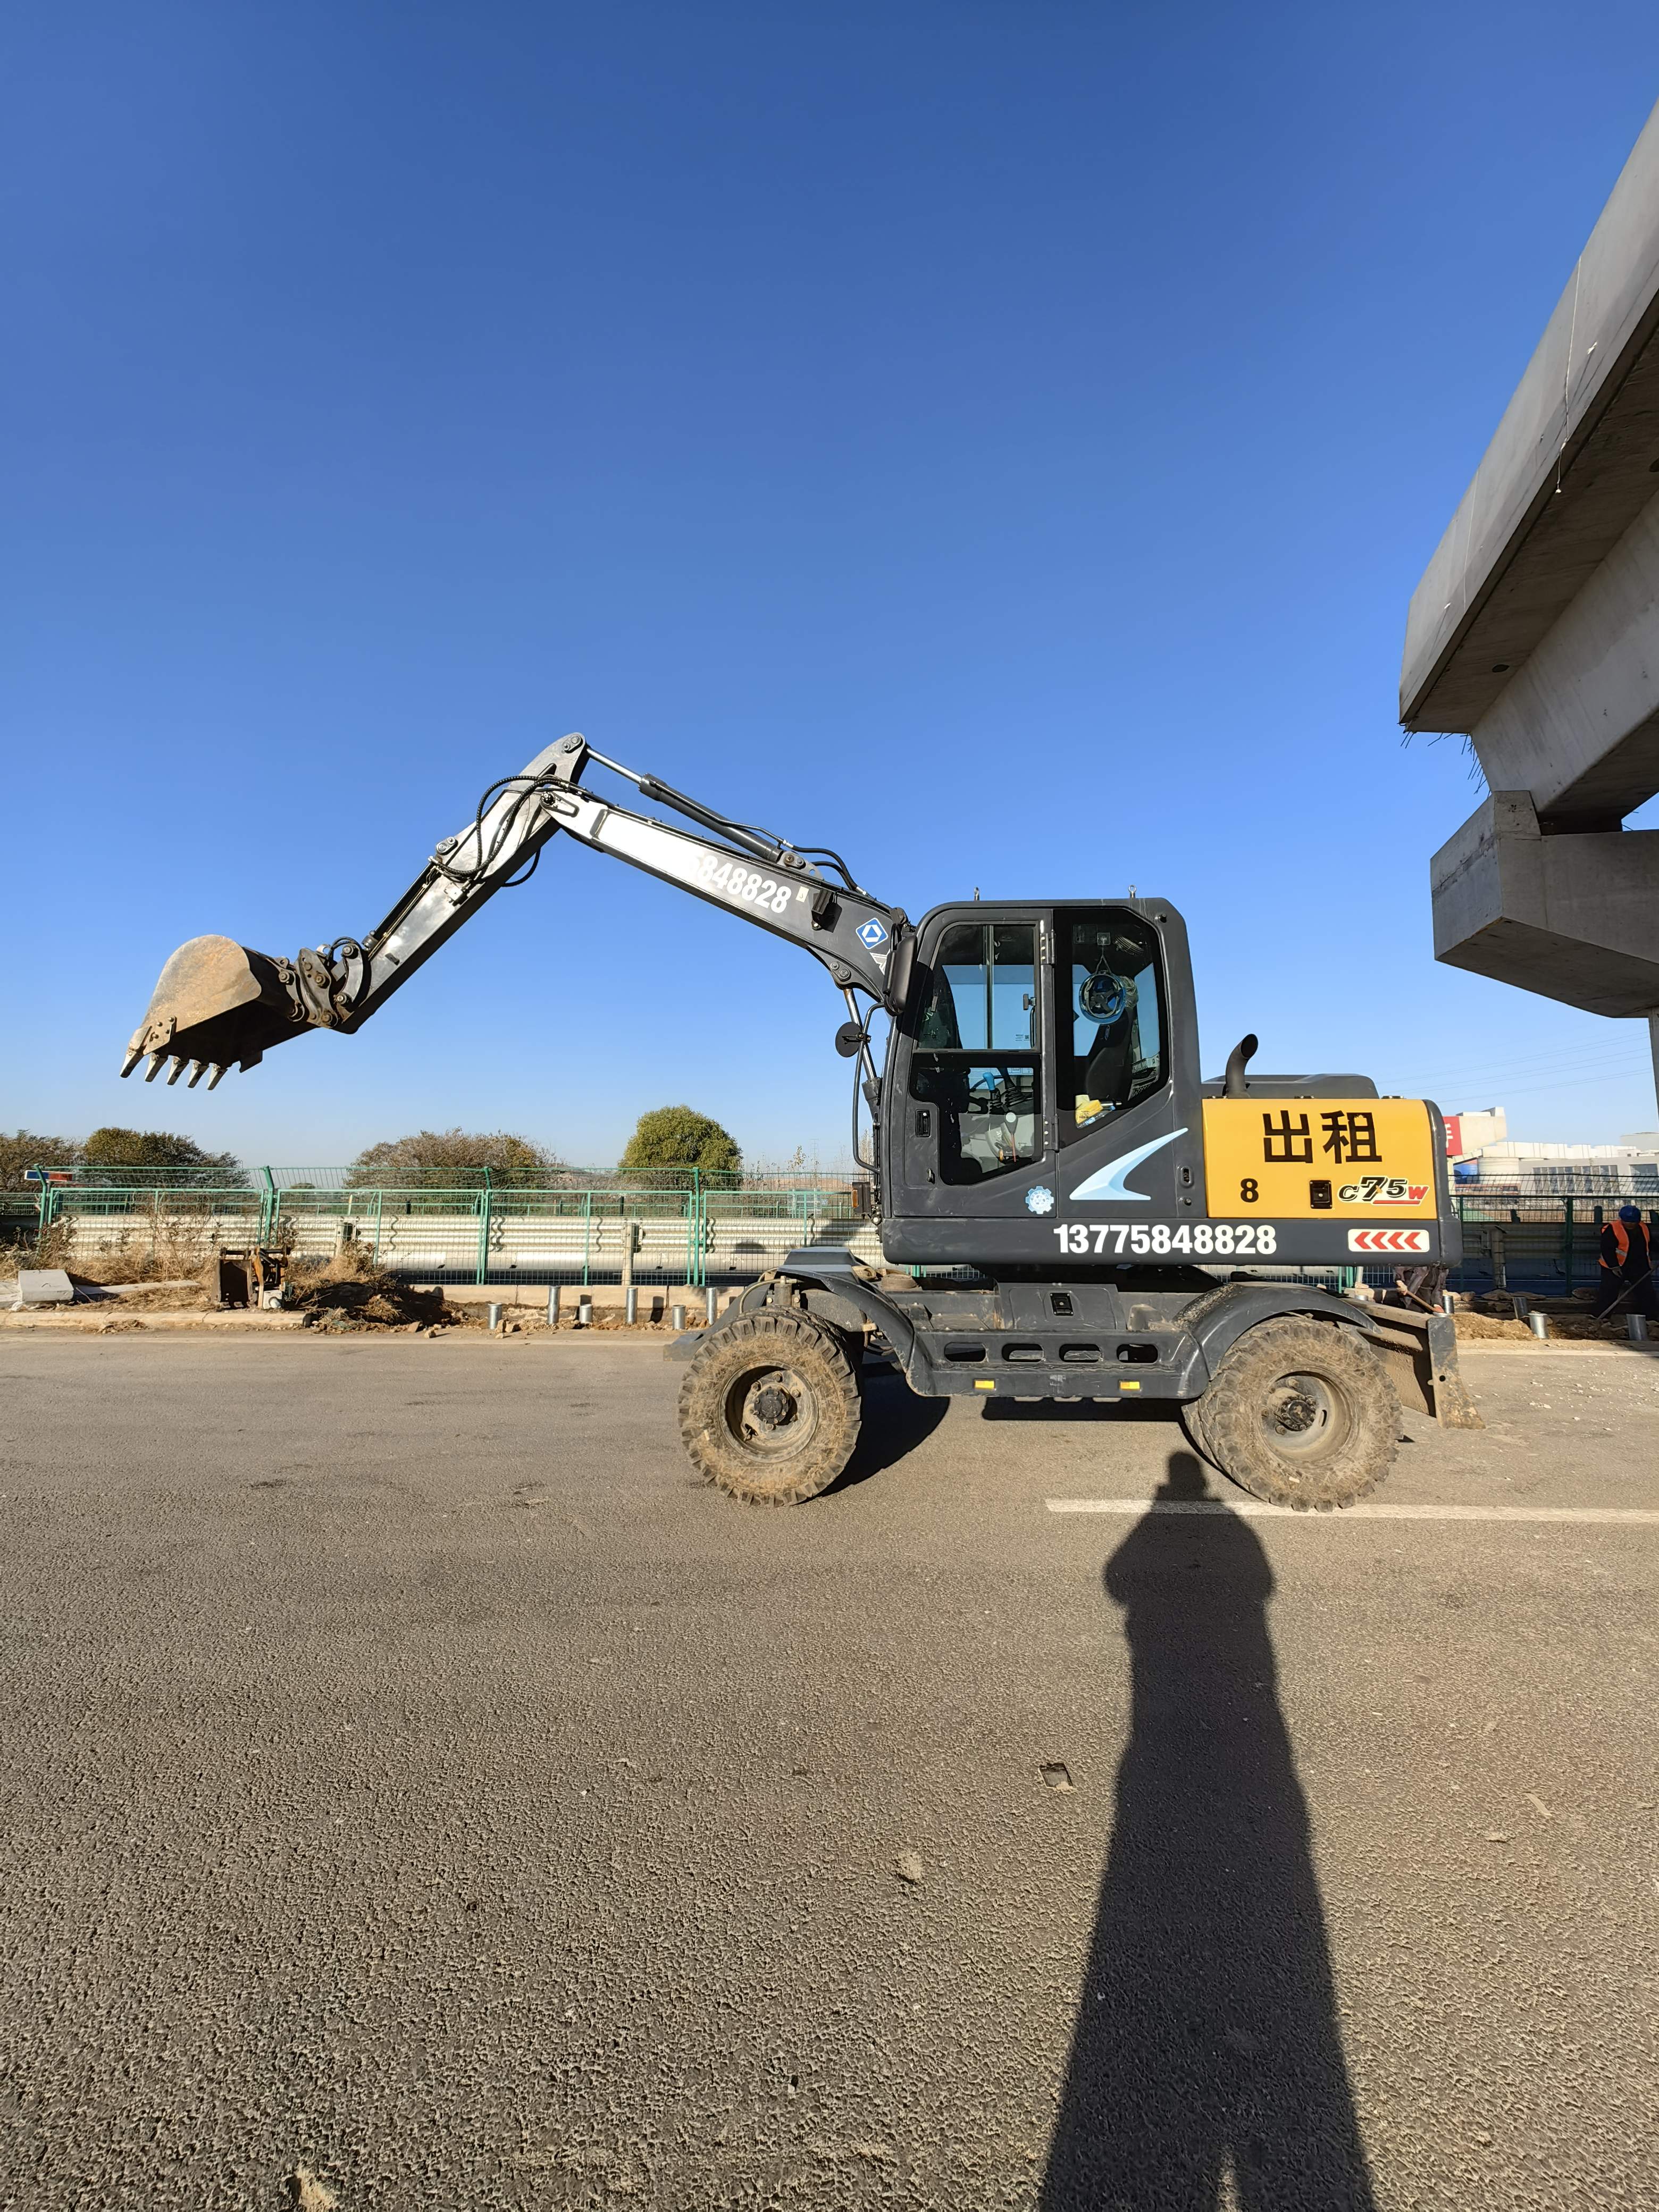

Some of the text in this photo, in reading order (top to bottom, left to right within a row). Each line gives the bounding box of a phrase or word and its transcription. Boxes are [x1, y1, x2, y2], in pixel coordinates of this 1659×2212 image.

[692, 854, 792, 914] 848828
[1262, 1110, 1382, 1164] 出租
[1241, 1178, 1259, 1203] 8
[1053, 1224, 1277, 1254] 13775848828
